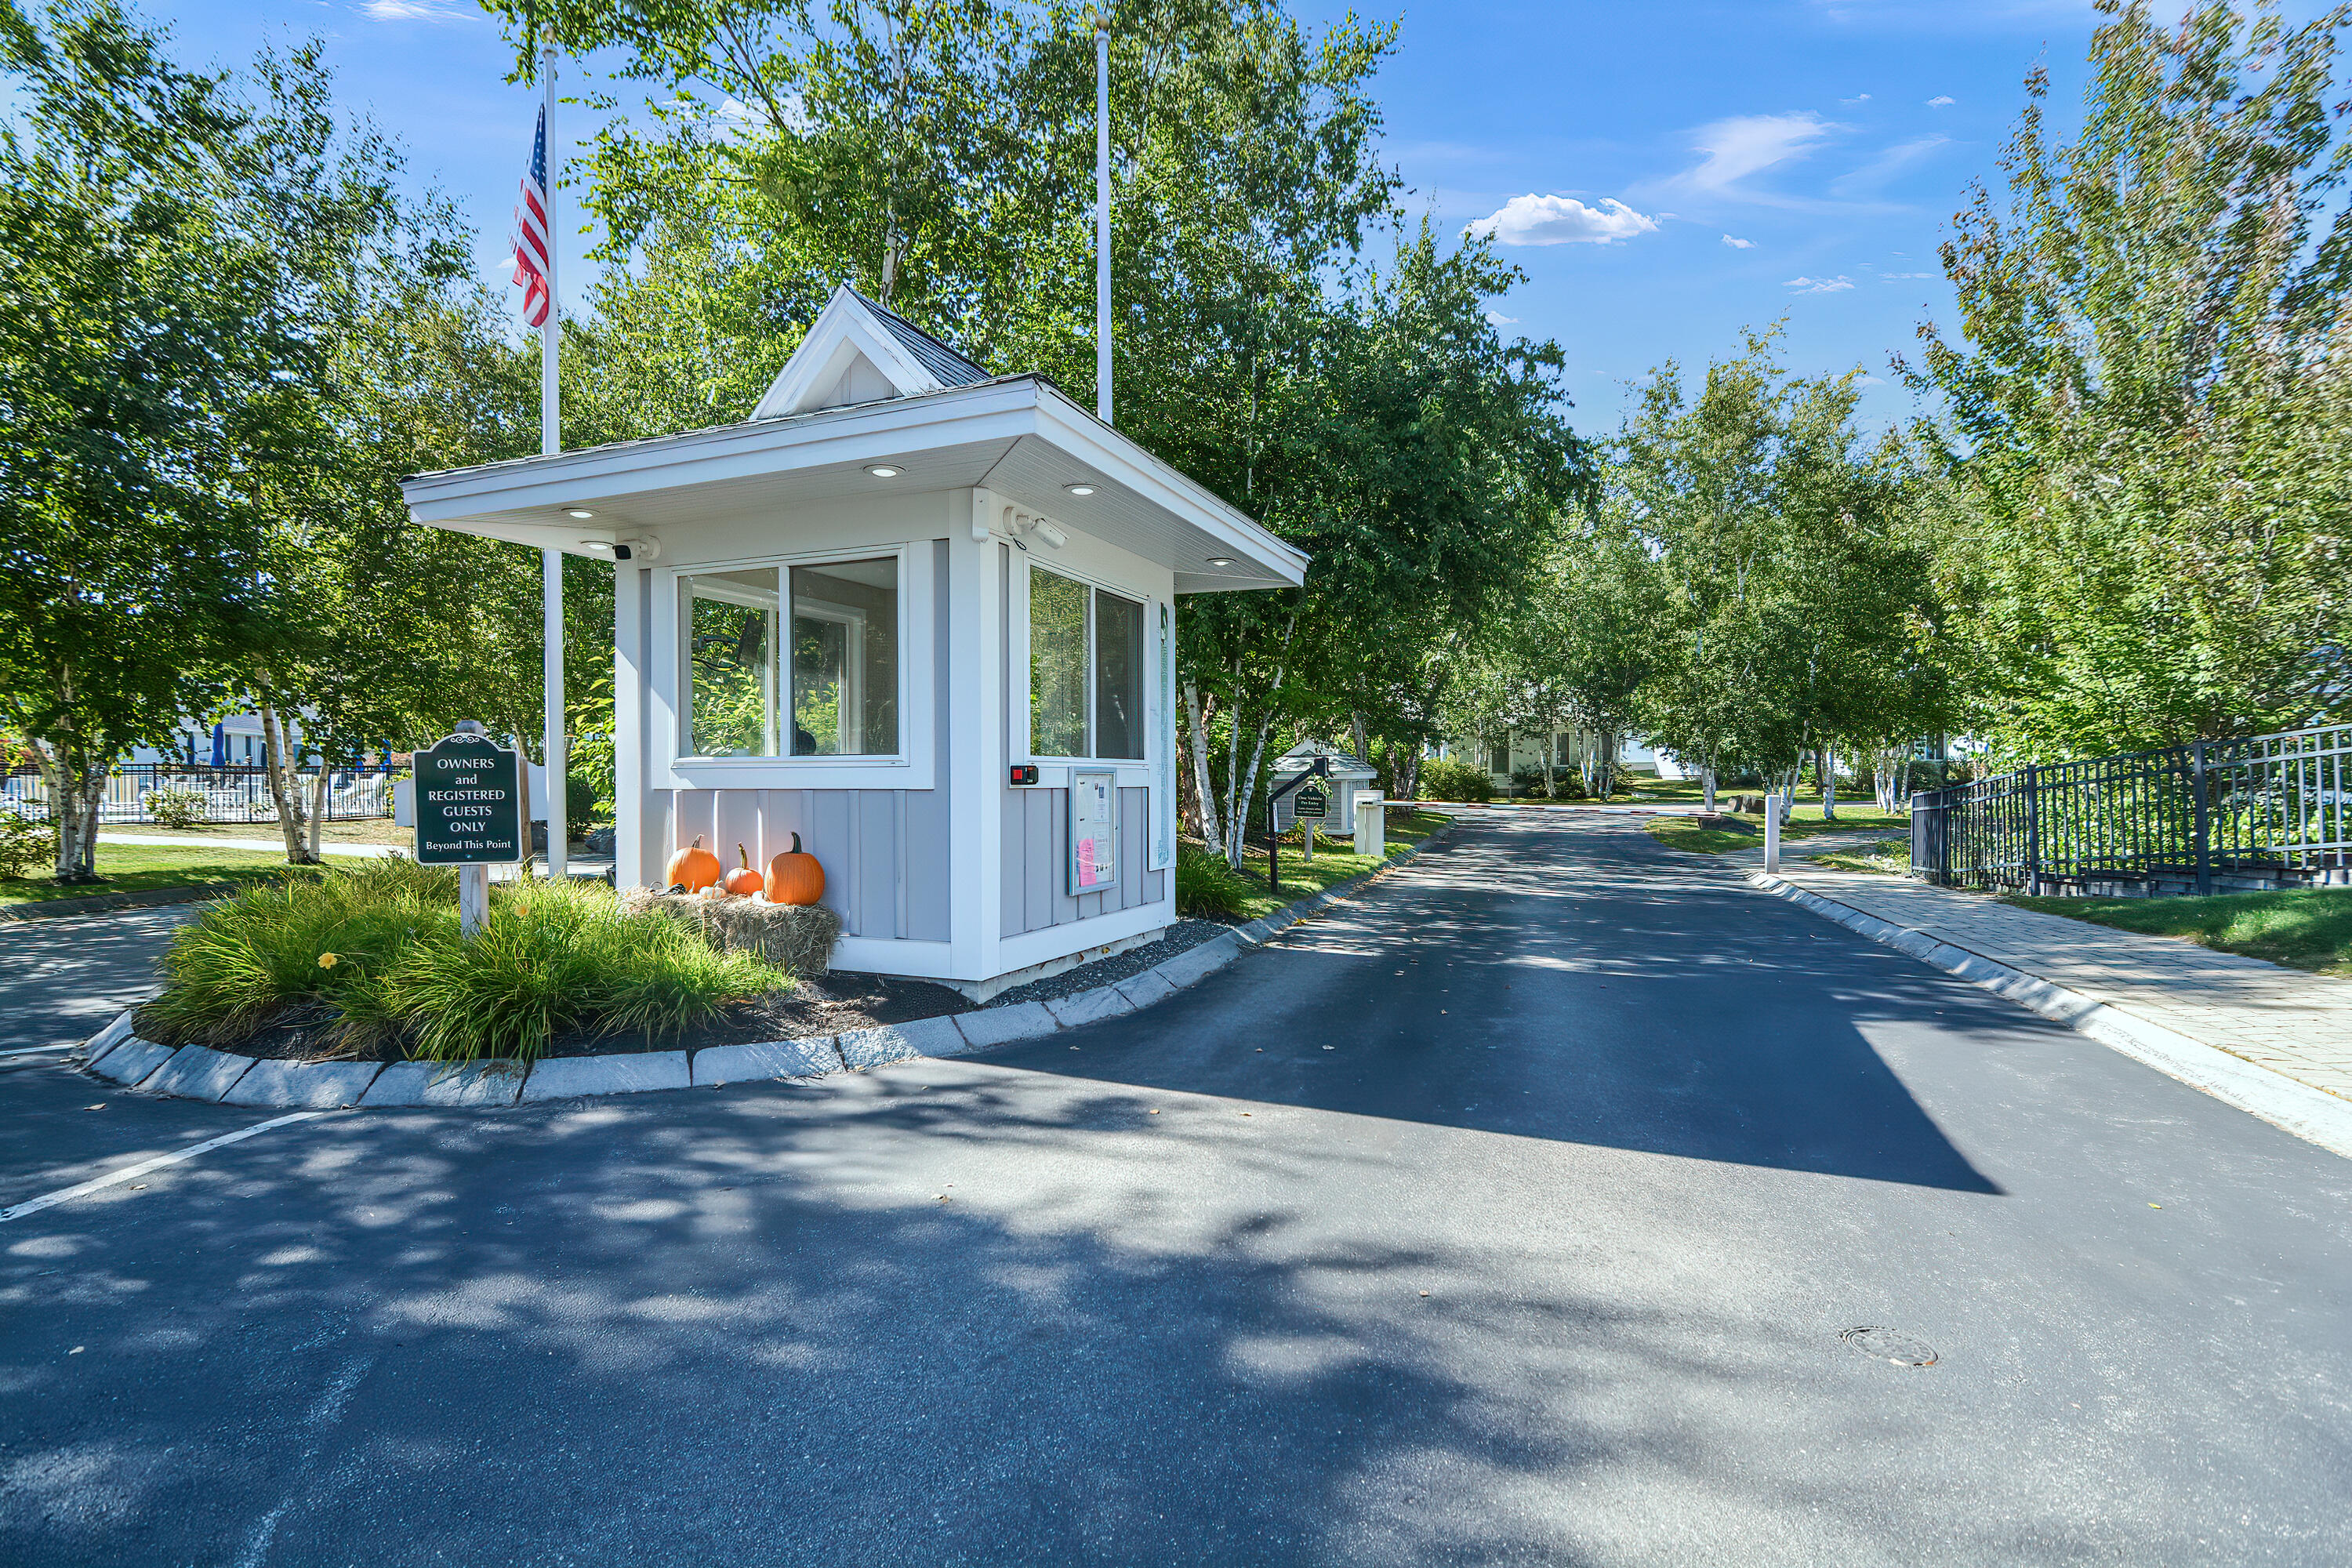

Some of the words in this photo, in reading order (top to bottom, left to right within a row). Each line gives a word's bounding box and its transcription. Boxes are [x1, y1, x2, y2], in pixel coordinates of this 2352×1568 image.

[437, 758, 495, 769] OWNERS
[455, 774, 477, 785] and
[428, 789, 505, 800] REGISTERED
[443, 805, 492, 816] GUESTS
[450, 822, 486, 832] ONLY
[426, 840, 462, 851] Beyond
[463, 840, 484, 849] This
[486, 840, 511, 848] Point
